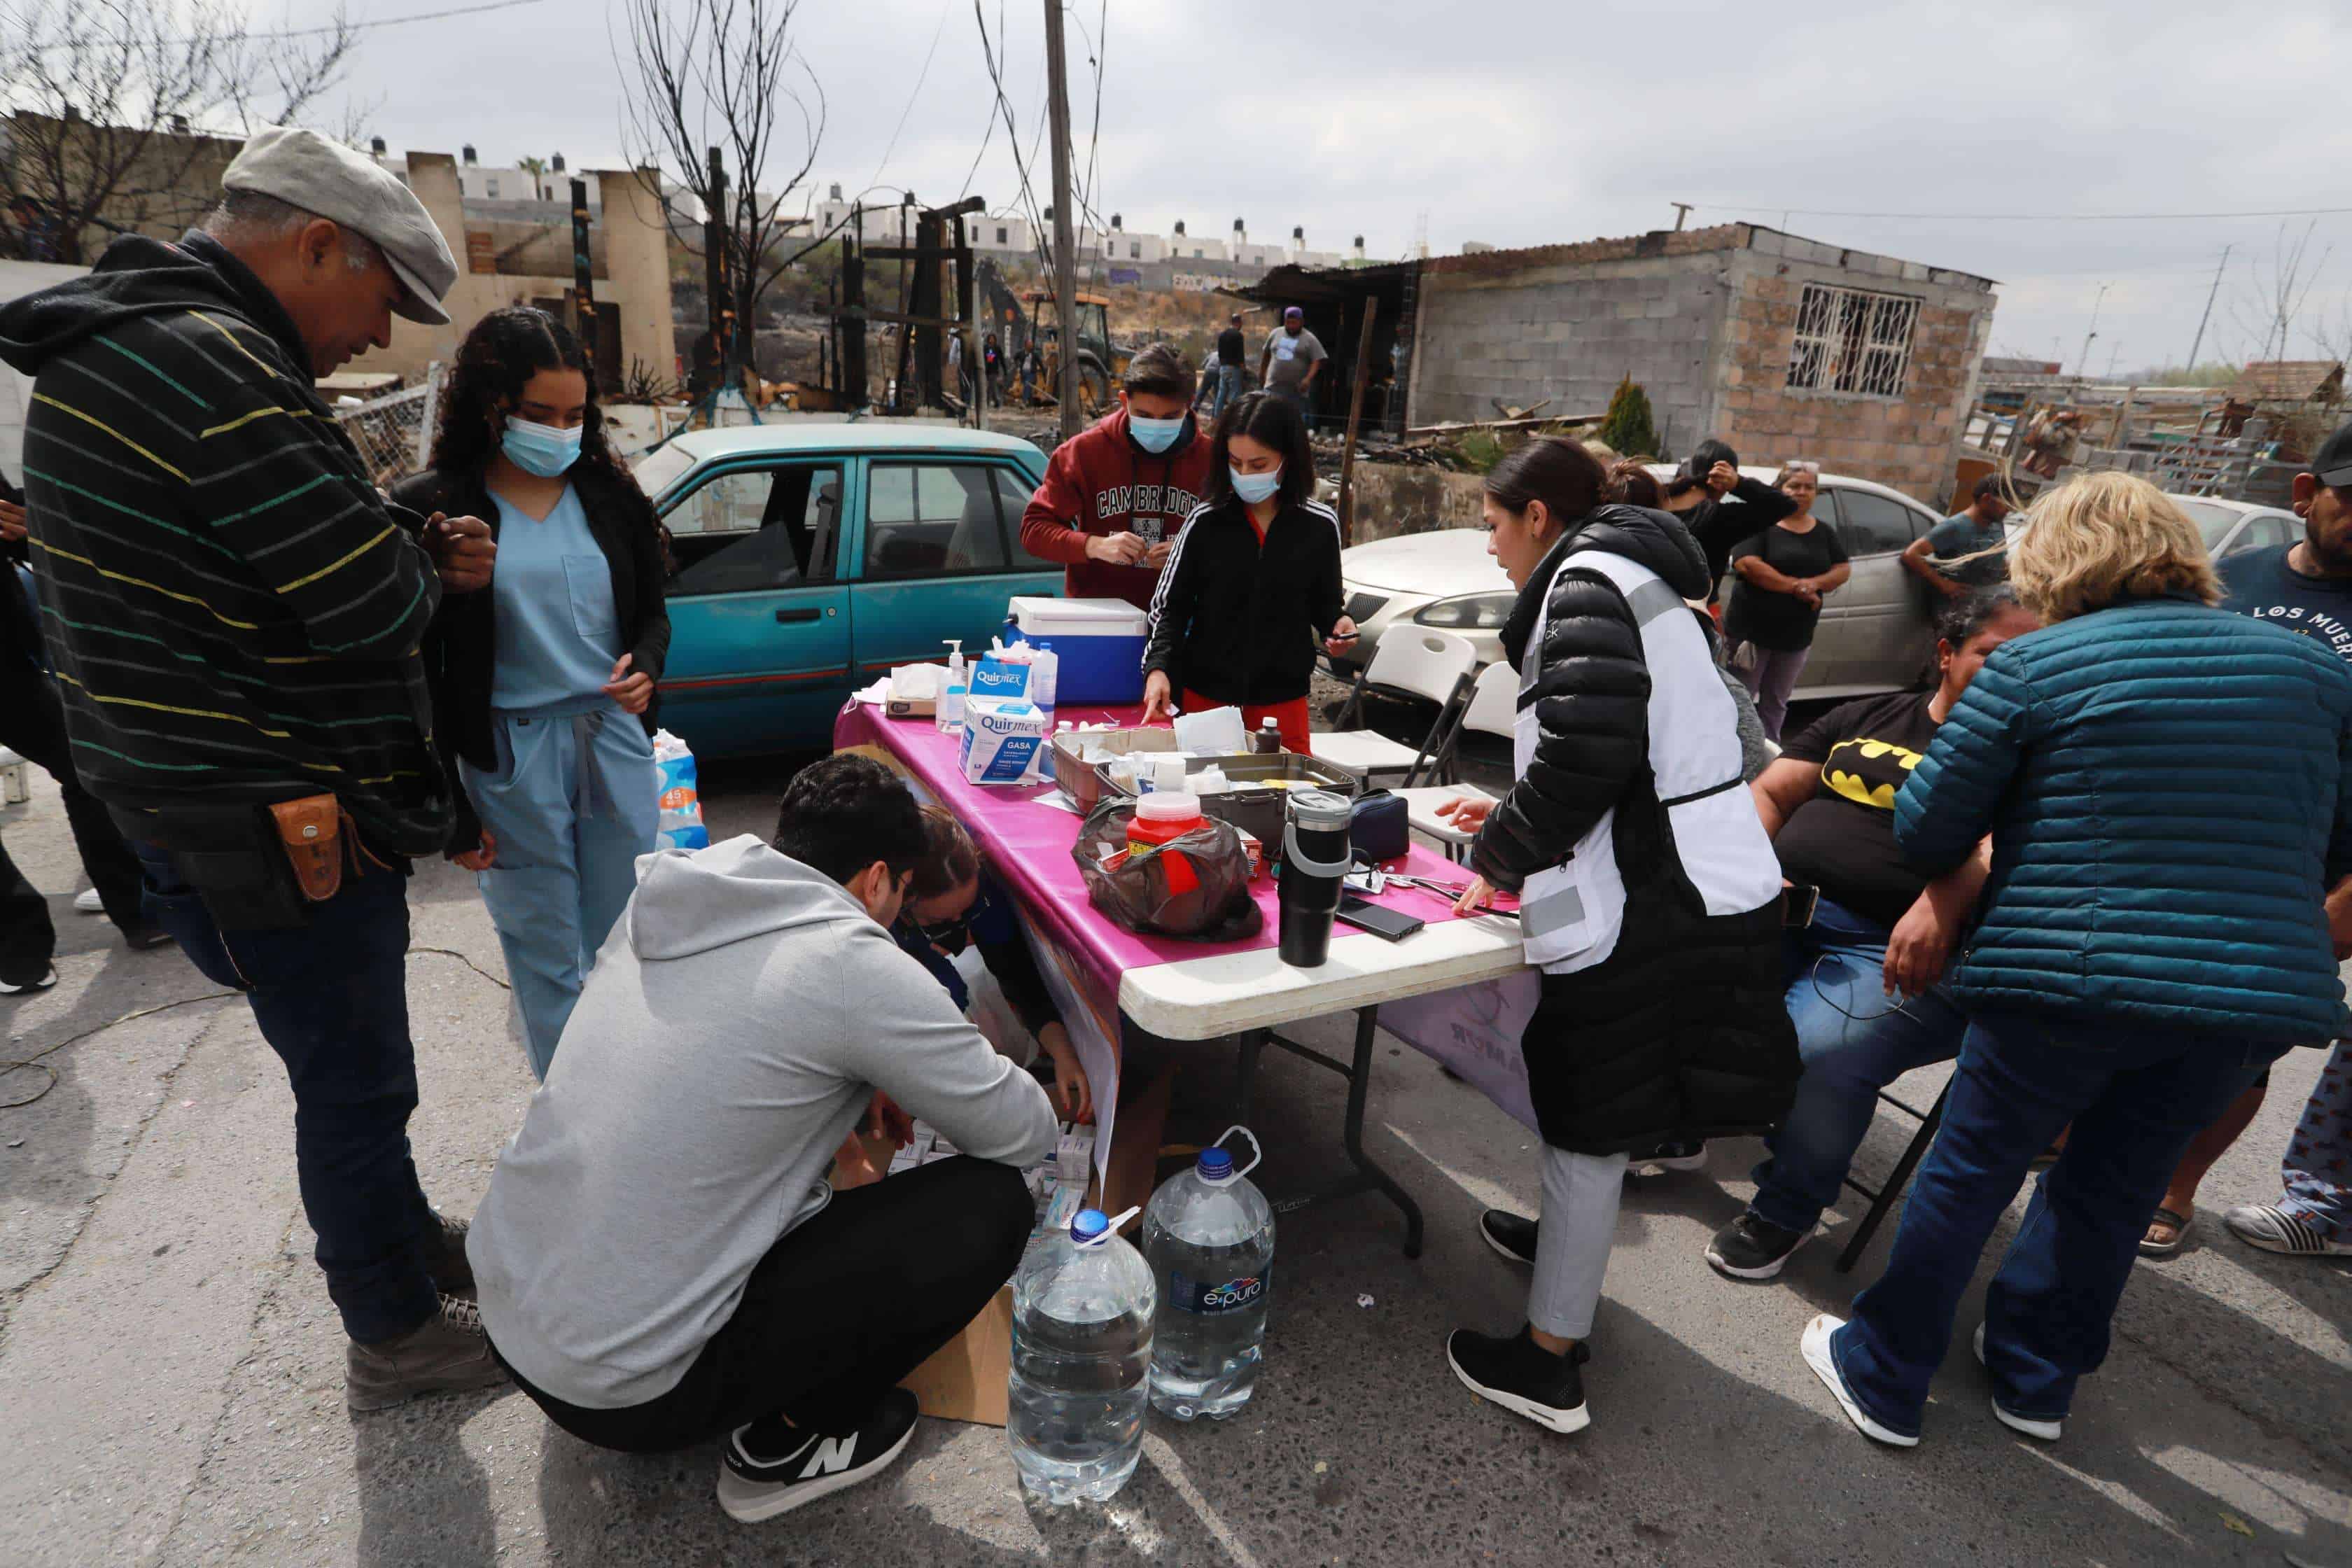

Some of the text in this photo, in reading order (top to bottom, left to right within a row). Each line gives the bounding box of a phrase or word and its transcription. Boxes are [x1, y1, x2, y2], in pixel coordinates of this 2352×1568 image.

[2253, 606, 2306, 620] LOS
[976, 671, 1023, 687] Quirmex
[981, 715, 1042, 735] Quirmex
[1007, 741, 1031, 750] GASA
